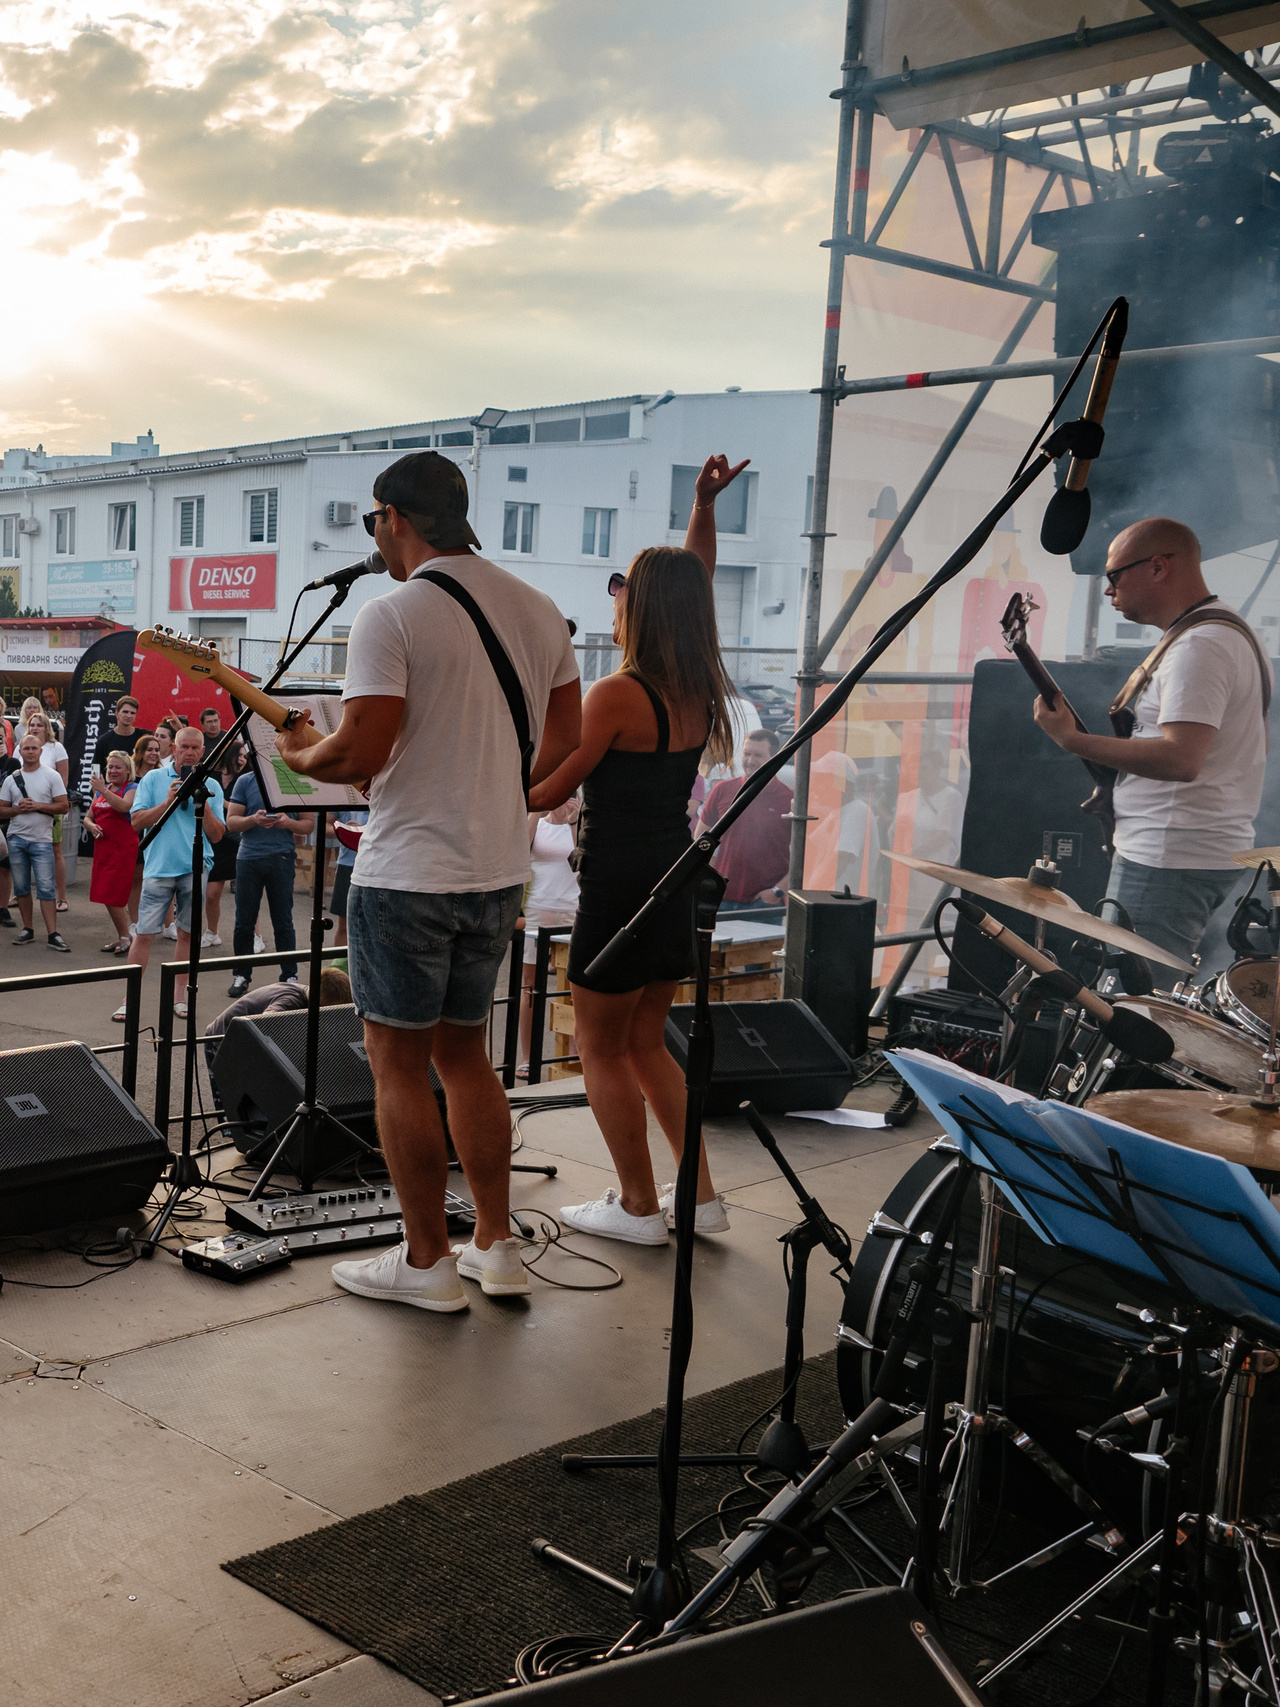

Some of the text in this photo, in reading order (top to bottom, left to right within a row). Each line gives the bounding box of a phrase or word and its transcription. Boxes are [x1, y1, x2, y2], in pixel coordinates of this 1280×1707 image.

[198, 566, 257, 587] DENSO
[203, 589, 250, 600] DIESEL SERVICE
[7, 655, 82, 665] ПИВОВАРНЯ SCHON
[1056, 838, 1073, 860] JBL
[14, 1100, 39, 1112] JBL
